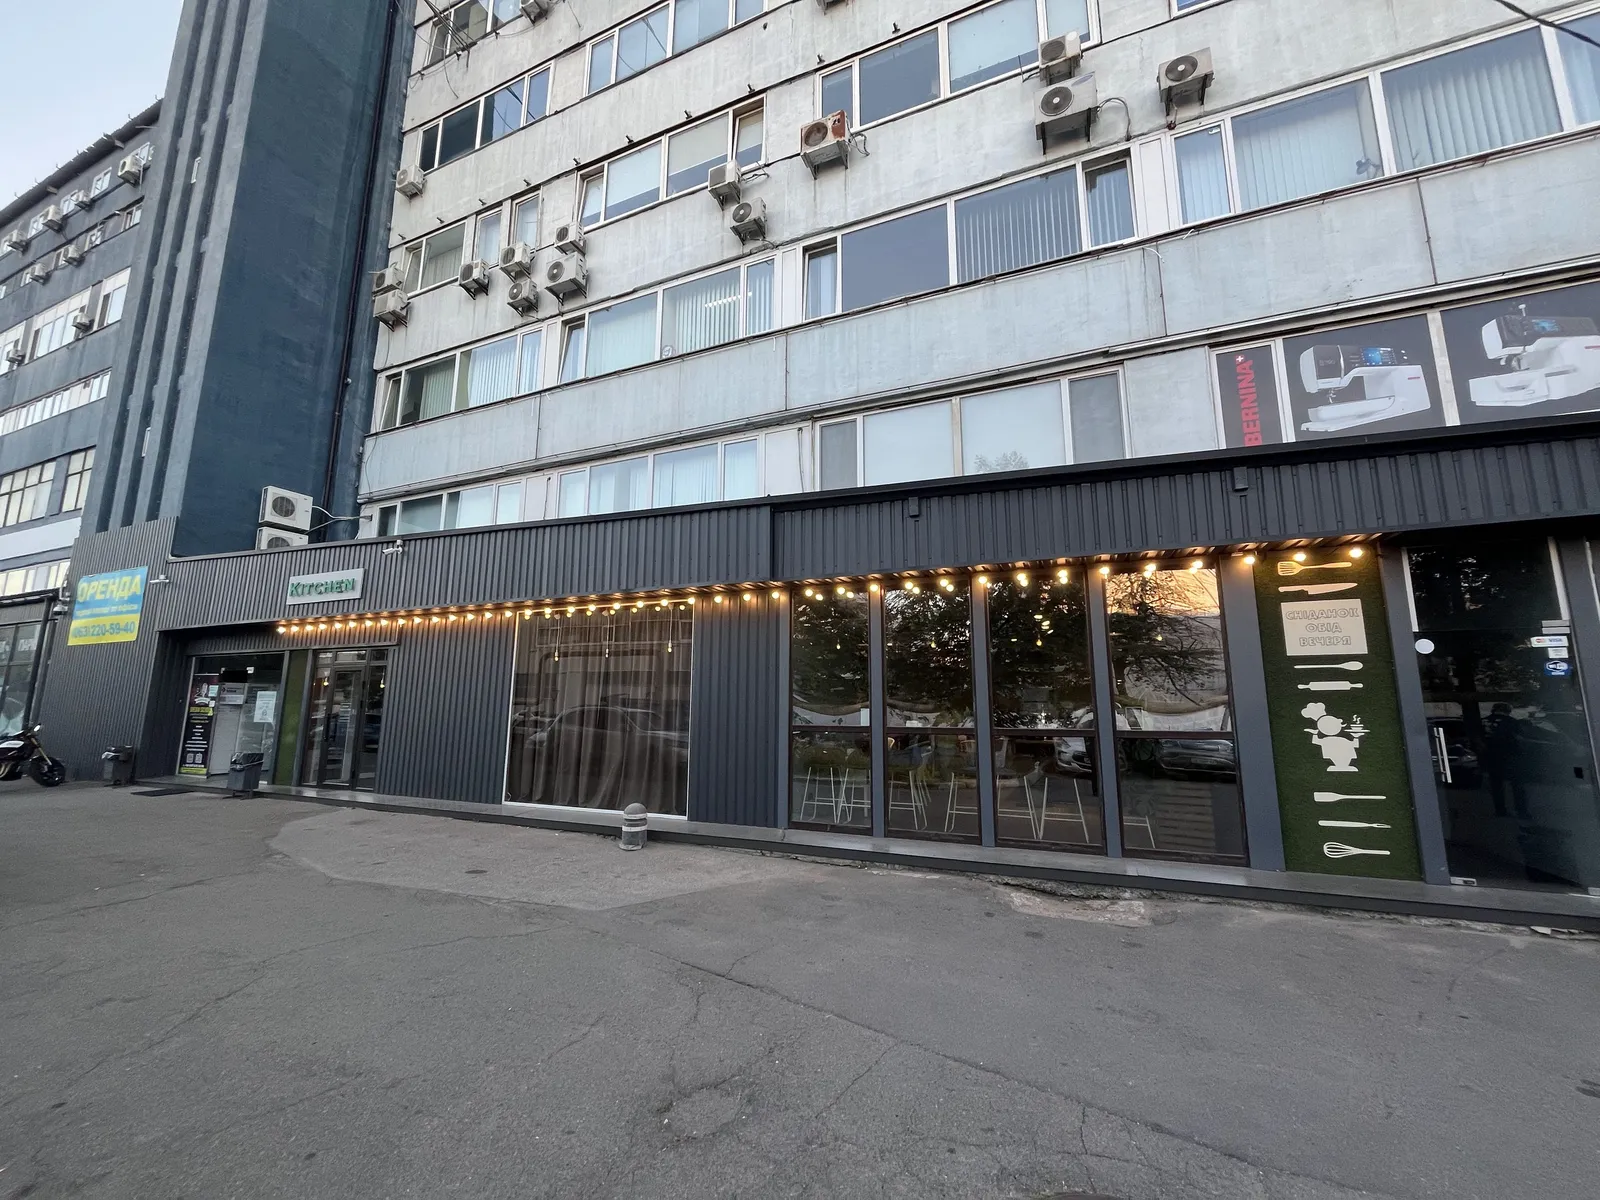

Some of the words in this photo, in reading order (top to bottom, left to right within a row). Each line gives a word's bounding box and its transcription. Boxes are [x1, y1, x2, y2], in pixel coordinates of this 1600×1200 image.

[1236, 359, 1262, 447] BERNINA
[77, 574, 141, 603] ОРЕНДА
[289, 577, 356, 598] KITCHEN
[1285, 607, 1360, 620] СНІДАНОК
[1305, 622, 1342, 633] ОБІД
[1298, 636, 1352, 647] ВЕЧЕРЯ
